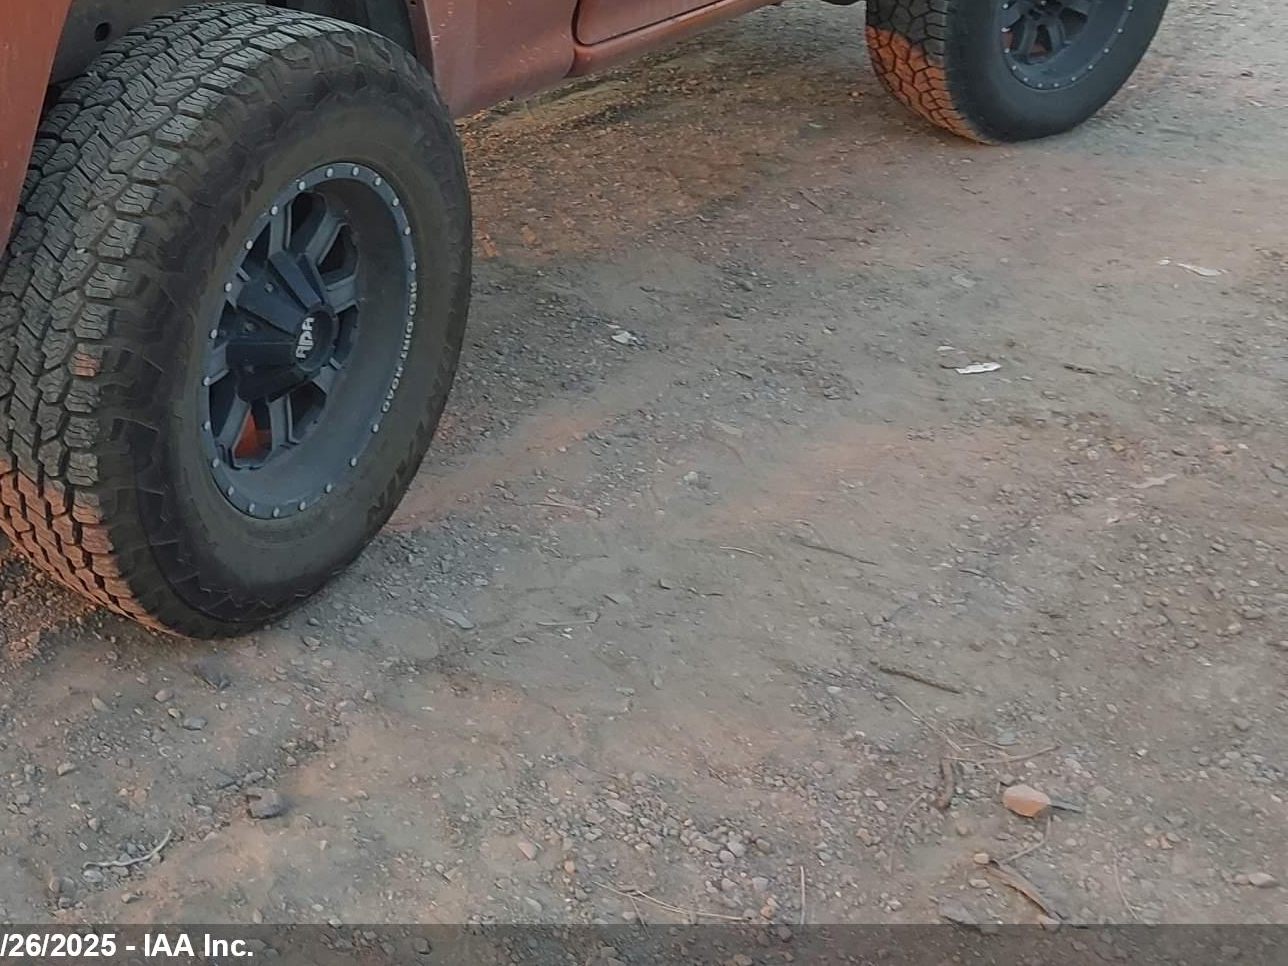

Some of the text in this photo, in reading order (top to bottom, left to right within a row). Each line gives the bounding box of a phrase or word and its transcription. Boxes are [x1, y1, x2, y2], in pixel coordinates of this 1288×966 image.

[382, 281, 418, 413] RED DIRT ROAD
